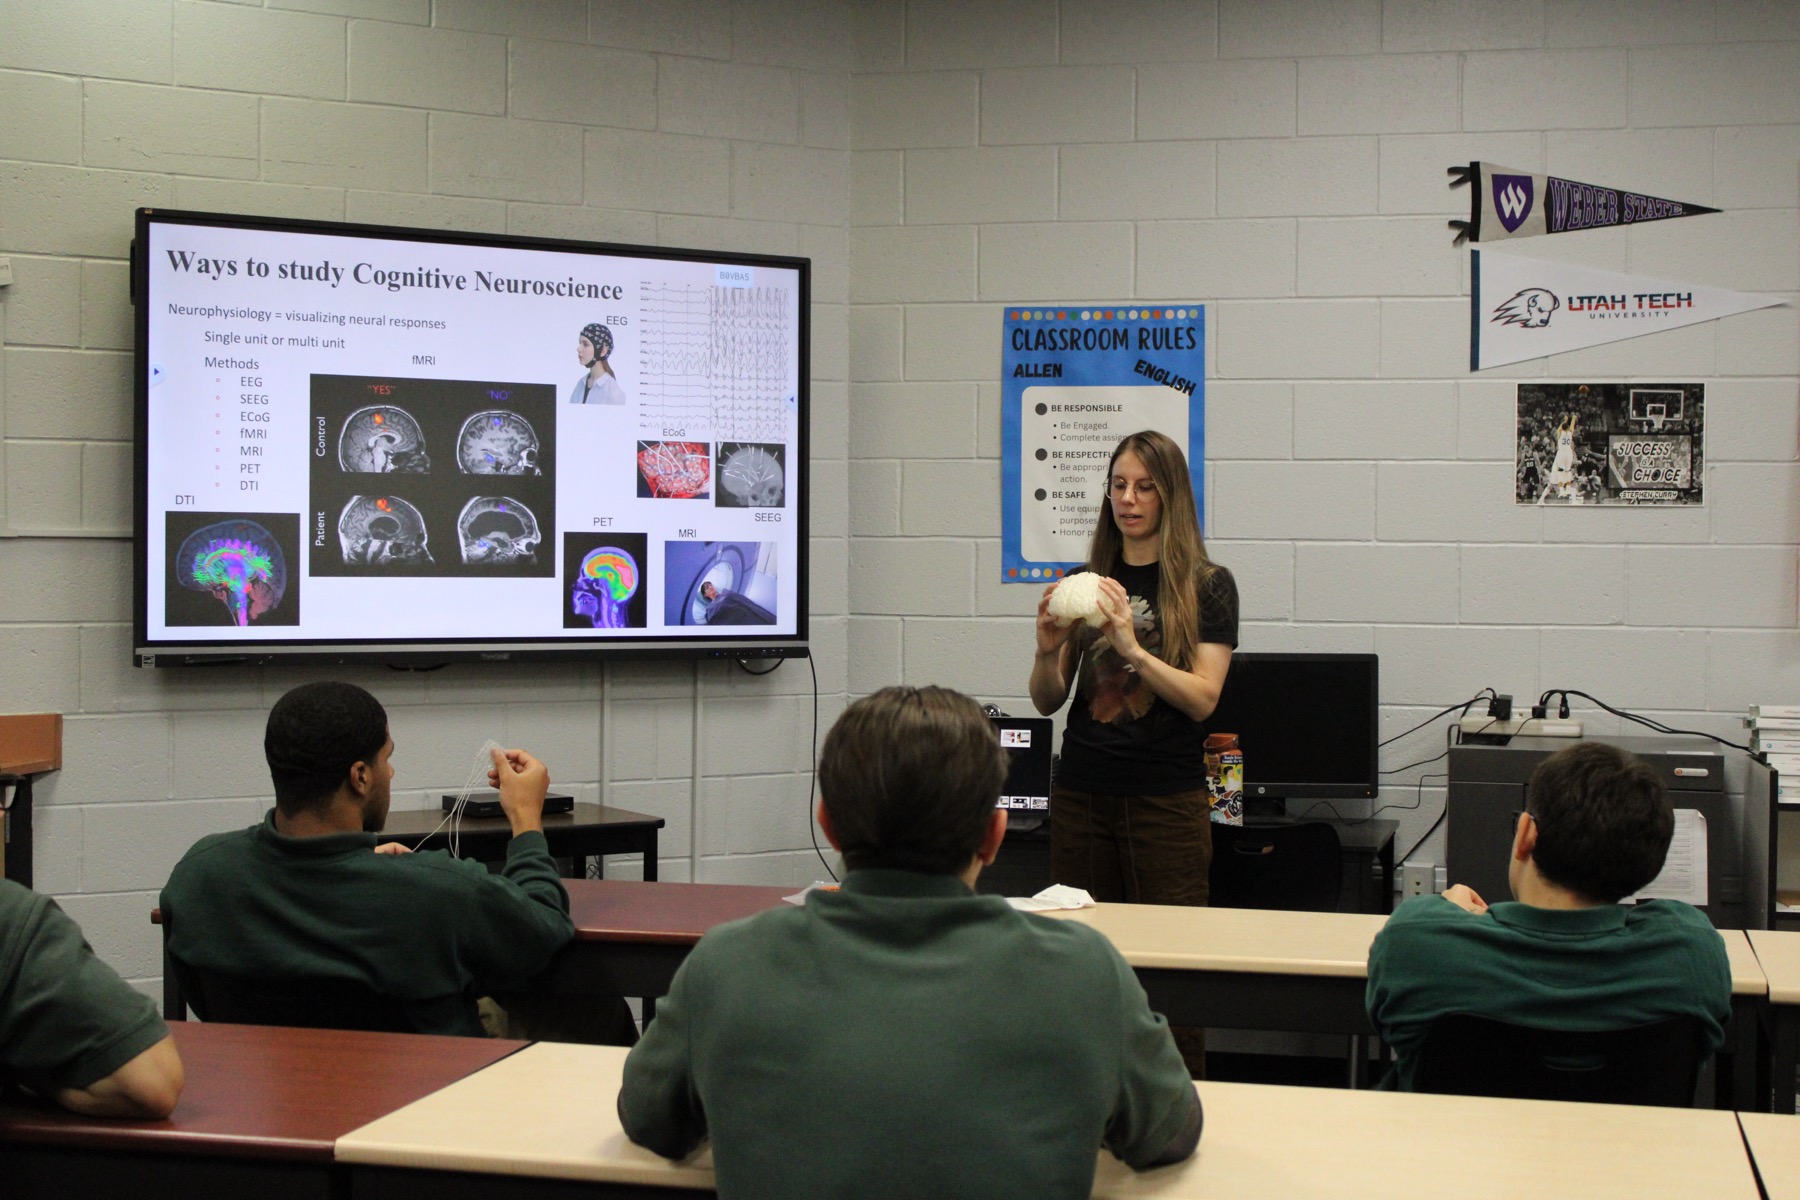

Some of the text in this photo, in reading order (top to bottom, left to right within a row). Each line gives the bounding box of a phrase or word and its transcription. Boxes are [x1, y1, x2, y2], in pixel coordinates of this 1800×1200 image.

[1550, 179, 1683, 231] WEBER STATE
[166, 250, 623, 300] Ways to study Cognitive Neuroscience
[1568, 292, 1692, 311] UTAH TECH
[168, 303, 272, 322] Neurophysiology
[285, 309, 346, 326] visualizing
[349, 313, 386, 326] neural
[389, 317, 446, 330] responses
[1589, 310, 1670, 319] UNIVERSITY
[606, 315, 628, 326] EEG
[204, 331, 345, 349] Single unit or multi unit
[1011, 326, 1196, 351] CLASSROOM RULES
[204, 356, 259, 370] Methods
[412, 355, 436, 366] fMRI
[1013, 363, 1062, 378] ALLEN
[240, 376, 263, 388] EEG
[1134, 359, 1197, 396] ENGLISH
[240, 394, 269, 405] SEEG
[240, 411, 270, 422] ECoG
[662, 428, 686, 437] ECoG
[1074, 422, 1109, 432] Engaged.
[240, 428, 267, 439] fMRI
[316, 416, 326, 457] Control
[1060, 434, 1100, 444] Complete
[1561, 437, 1571, 446] 30
[240, 446, 263, 457] MRI
[1066, 451, 1112, 459] RESPECTFU
[240, 463, 261, 474] PET
[1060, 463, 1108, 473] Be appropri
[1633, 468, 1681, 483] CHOICE
[240, 480, 259, 491] DTI
[175, 495, 195, 505] DTI
[1065, 491, 1086, 499] SAFE
[1077, 505, 1100, 514] equip
[593, 517, 614, 527] PET
[754, 512, 782, 523] SEEG
[315, 511, 325, 547] Patient
[678, 528, 697, 538] MRI
[1059, 528, 1085, 536] Honor
